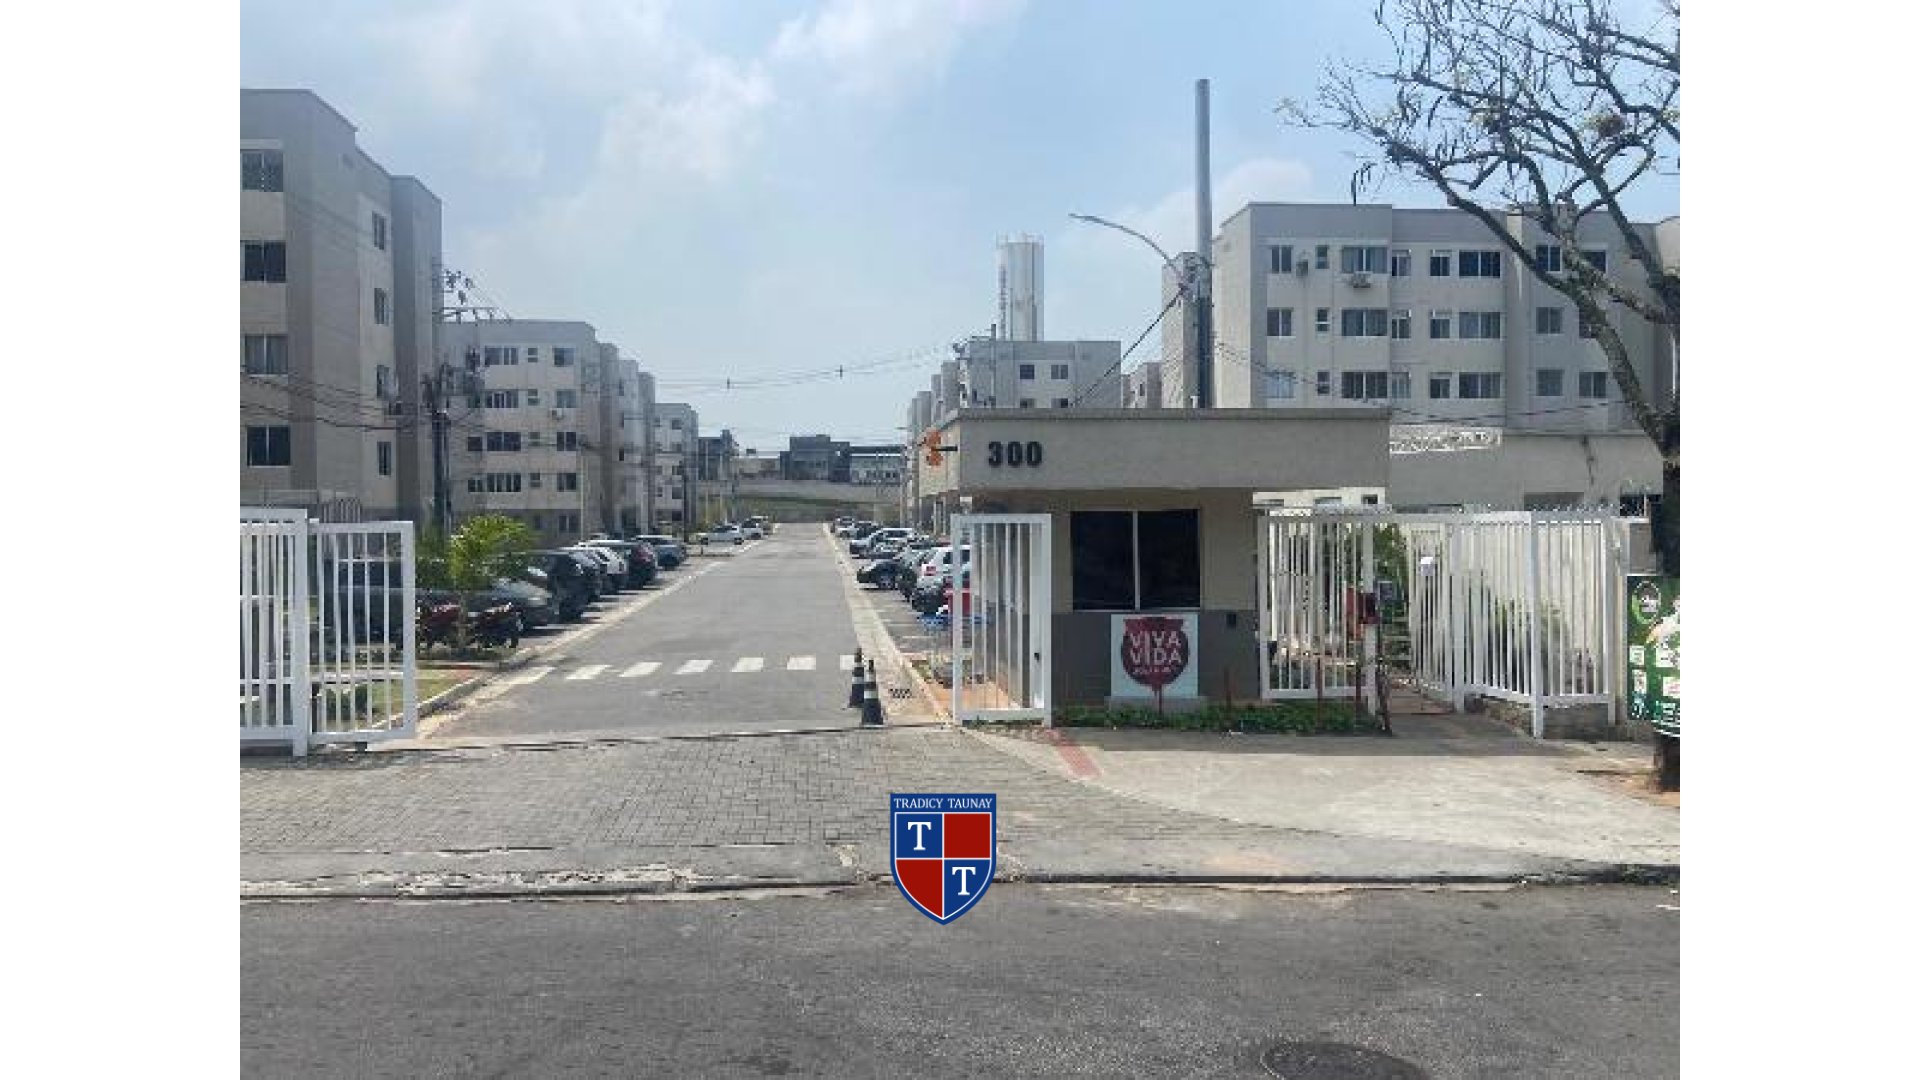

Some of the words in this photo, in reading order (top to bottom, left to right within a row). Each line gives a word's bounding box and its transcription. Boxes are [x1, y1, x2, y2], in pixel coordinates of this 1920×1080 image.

[988, 441, 1042, 468] 300
[1130, 631, 1181, 648] VIVA
[1130, 648, 1181, 666] VIDA
